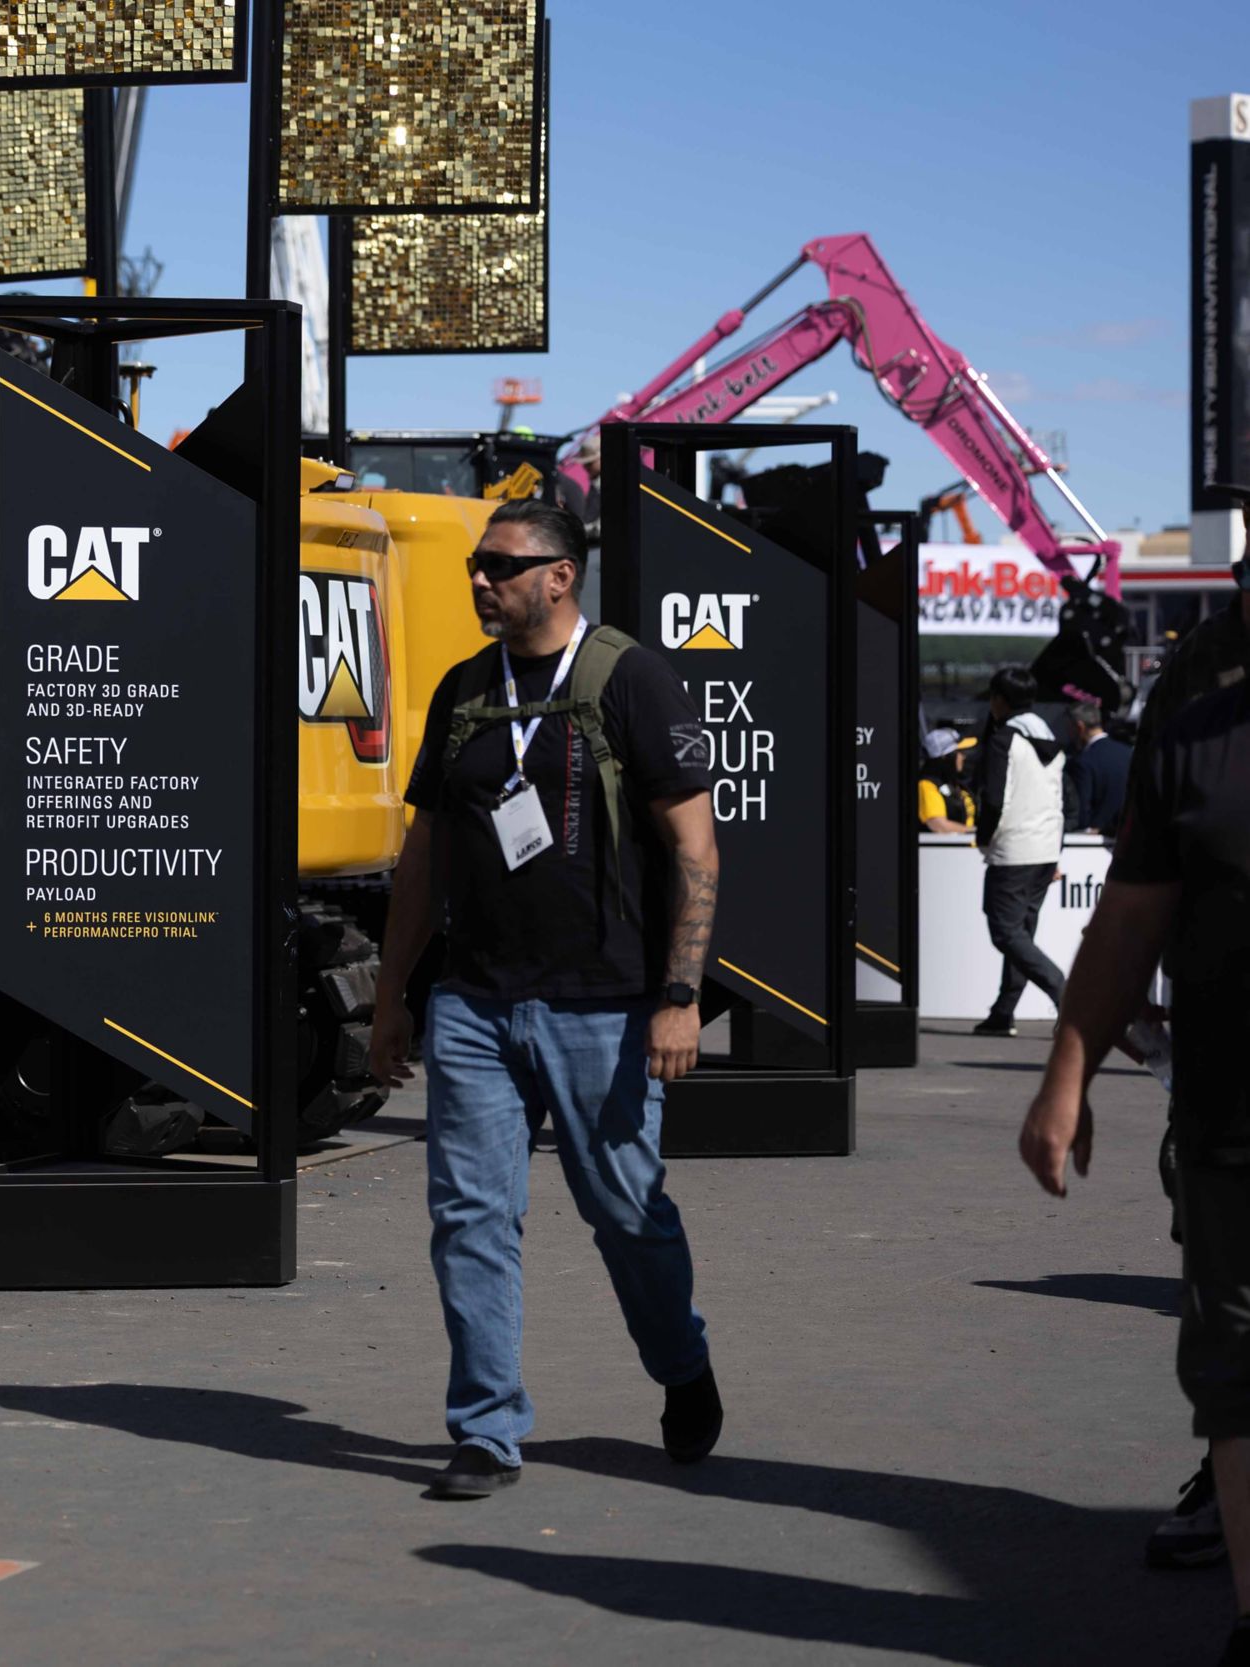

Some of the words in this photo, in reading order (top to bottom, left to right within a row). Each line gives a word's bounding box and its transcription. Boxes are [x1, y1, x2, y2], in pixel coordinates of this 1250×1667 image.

[947, 417, 1010, 493] DROMONE
[299, 575, 375, 717] CAT
[27, 644, 120, 673] GRADE
[27, 683, 97, 698] FACTORY
[101, 683, 121, 698] 3D
[127, 683, 180, 698] GRADE
[683, 680, 754, 723] EX
[26, 702, 60, 717] AND
[66, 703, 144, 717] 3D-READY
[25, 736, 128, 765] SAFETY
[701, 729, 775, 773] OUR
[27, 775, 124, 790] INTEGRATED
[130, 775, 199, 790] FACTORY
[26, 794, 113, 810] OFFERINGS
[118, 795, 152, 810] AND
[713, 778, 766, 822] CH
[26, 814, 101, 829] RETROFIT
[106, 814, 189, 829] UPGRADES
[26, 848, 223, 877] PRODUCTIVITY
[26, 887, 96, 902] PAYLOAD
[44, 912, 51, 923] 6
[55, 911, 108, 923] MONTHS
[112, 911, 141, 923] FREE
[44, 926, 159, 938] PERFORMANCEPRO
[163, 926, 198, 938] TRIAL
